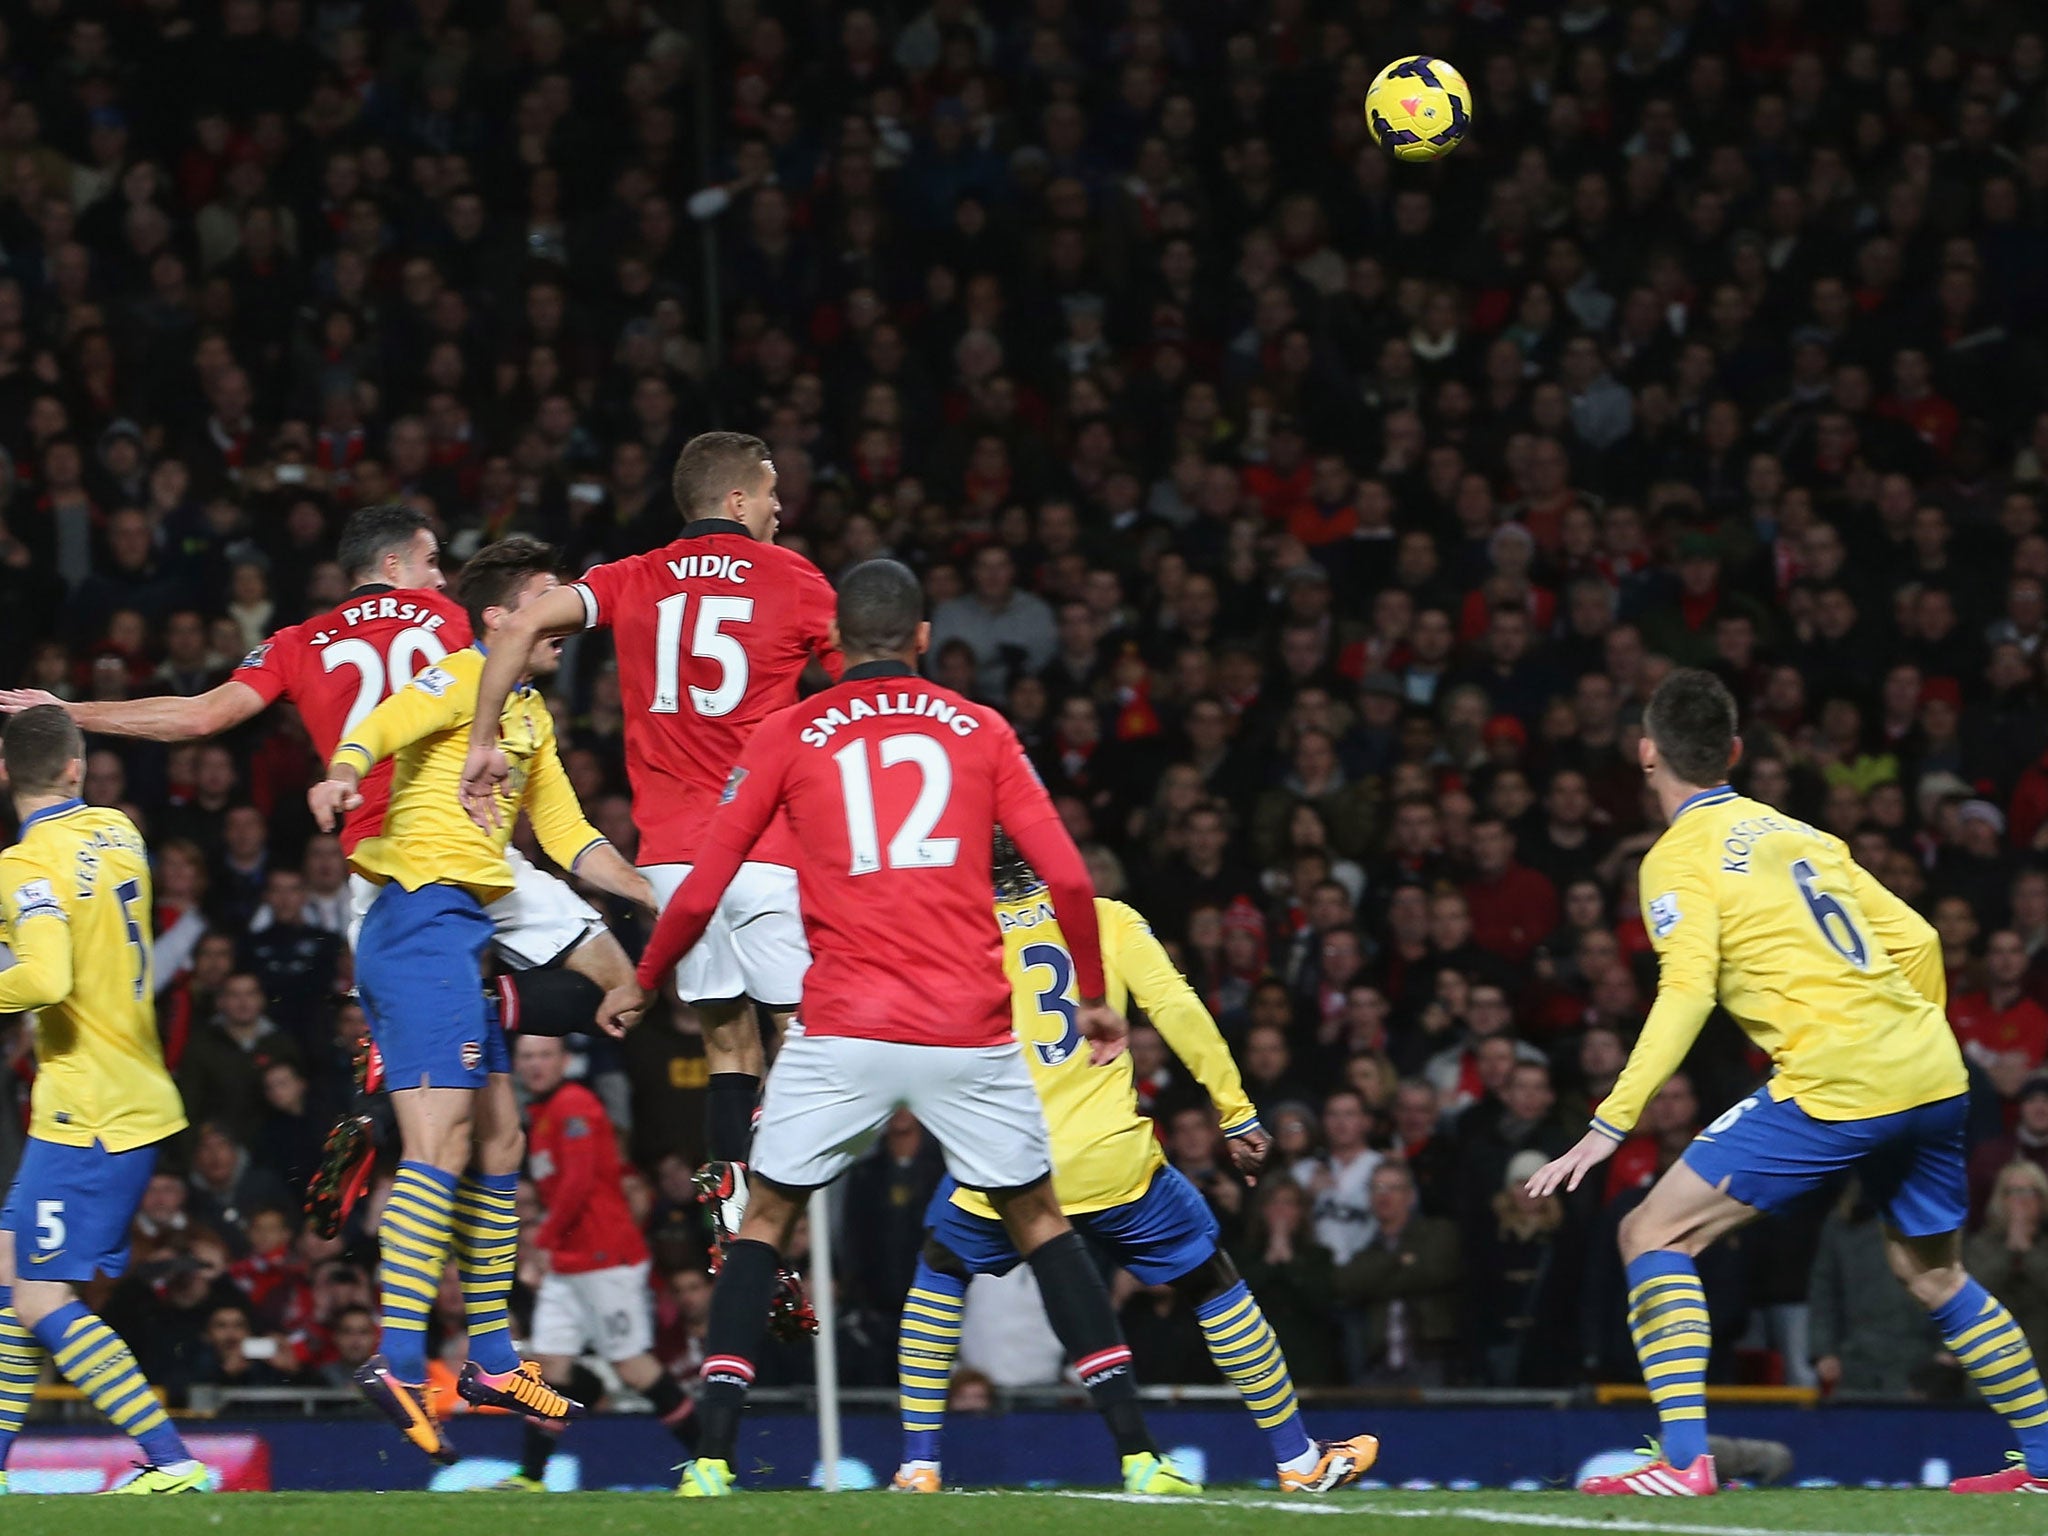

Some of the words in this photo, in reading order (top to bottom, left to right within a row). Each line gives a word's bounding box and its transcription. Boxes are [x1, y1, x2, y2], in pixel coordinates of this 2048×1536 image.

[342, 597, 446, 632] PERSIE
[666, 555, 753, 584] VIDIC
[320, 626, 449, 742] 20
[649, 592, 755, 717] 15
[800, 693, 980, 748] SMALLING
[831, 732, 961, 876] 12
[1790, 857, 1869, 974] 6
[1018, 942, 1085, 1066] 3
[35, 1199, 67, 1251] 5
